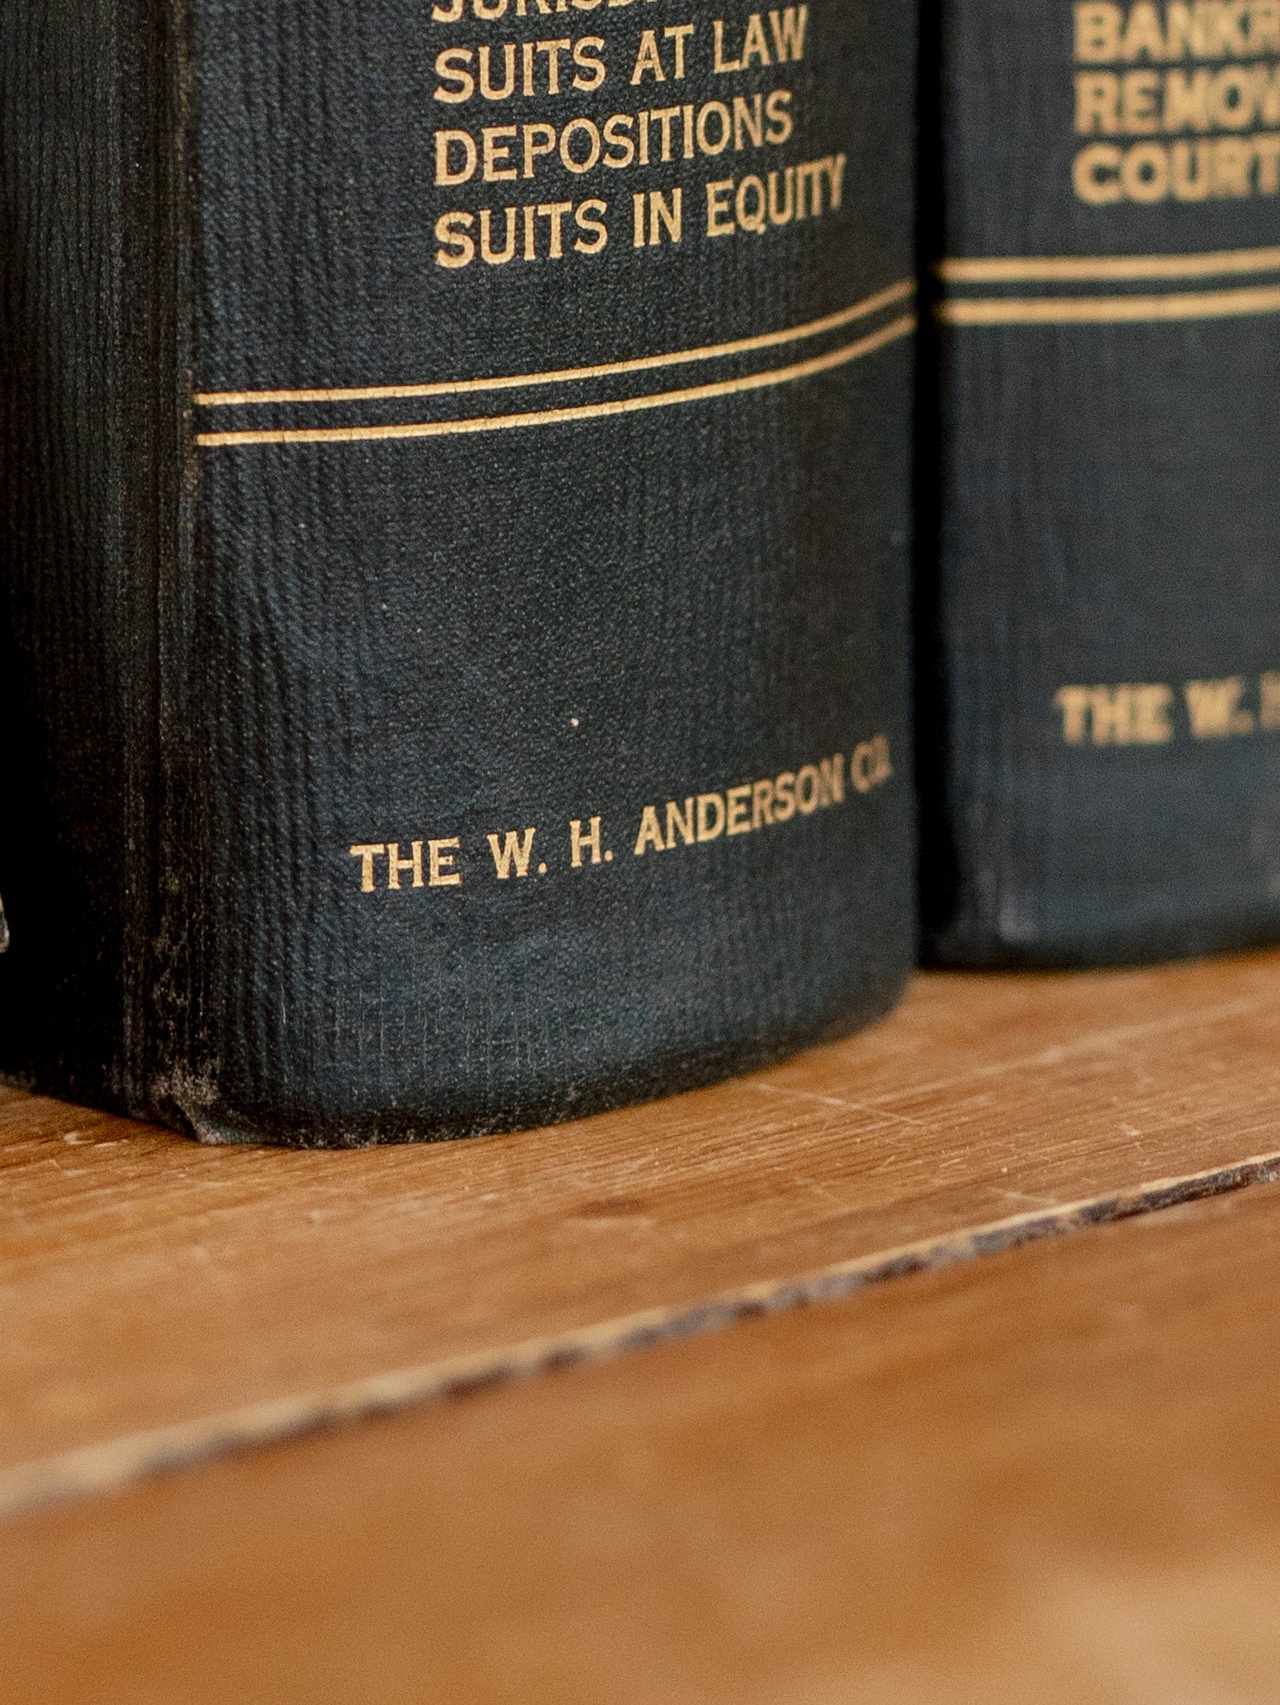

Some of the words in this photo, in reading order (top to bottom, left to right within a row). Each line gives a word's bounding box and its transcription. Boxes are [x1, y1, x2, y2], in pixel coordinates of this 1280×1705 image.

[433, 34, 607, 103] SUITS
[630, 23, 694, 85] AT
[713, 5, 807, 73] LAW
[433, 90, 793, 186] DEPOSITIONS
[434, 197, 609, 269] SUITS
[633, 186, 682, 247] IN
[705, 153, 846, 235] EQUITY
[1057, 684, 1171, 743] THE
[1186, 679, 1251, 736] W.
[349, 836, 463, 893] THE
[487, 826, 547, 879] W.
[569, 815, 614, 867] H.
[634, 754, 844, 854] ANDERSON
